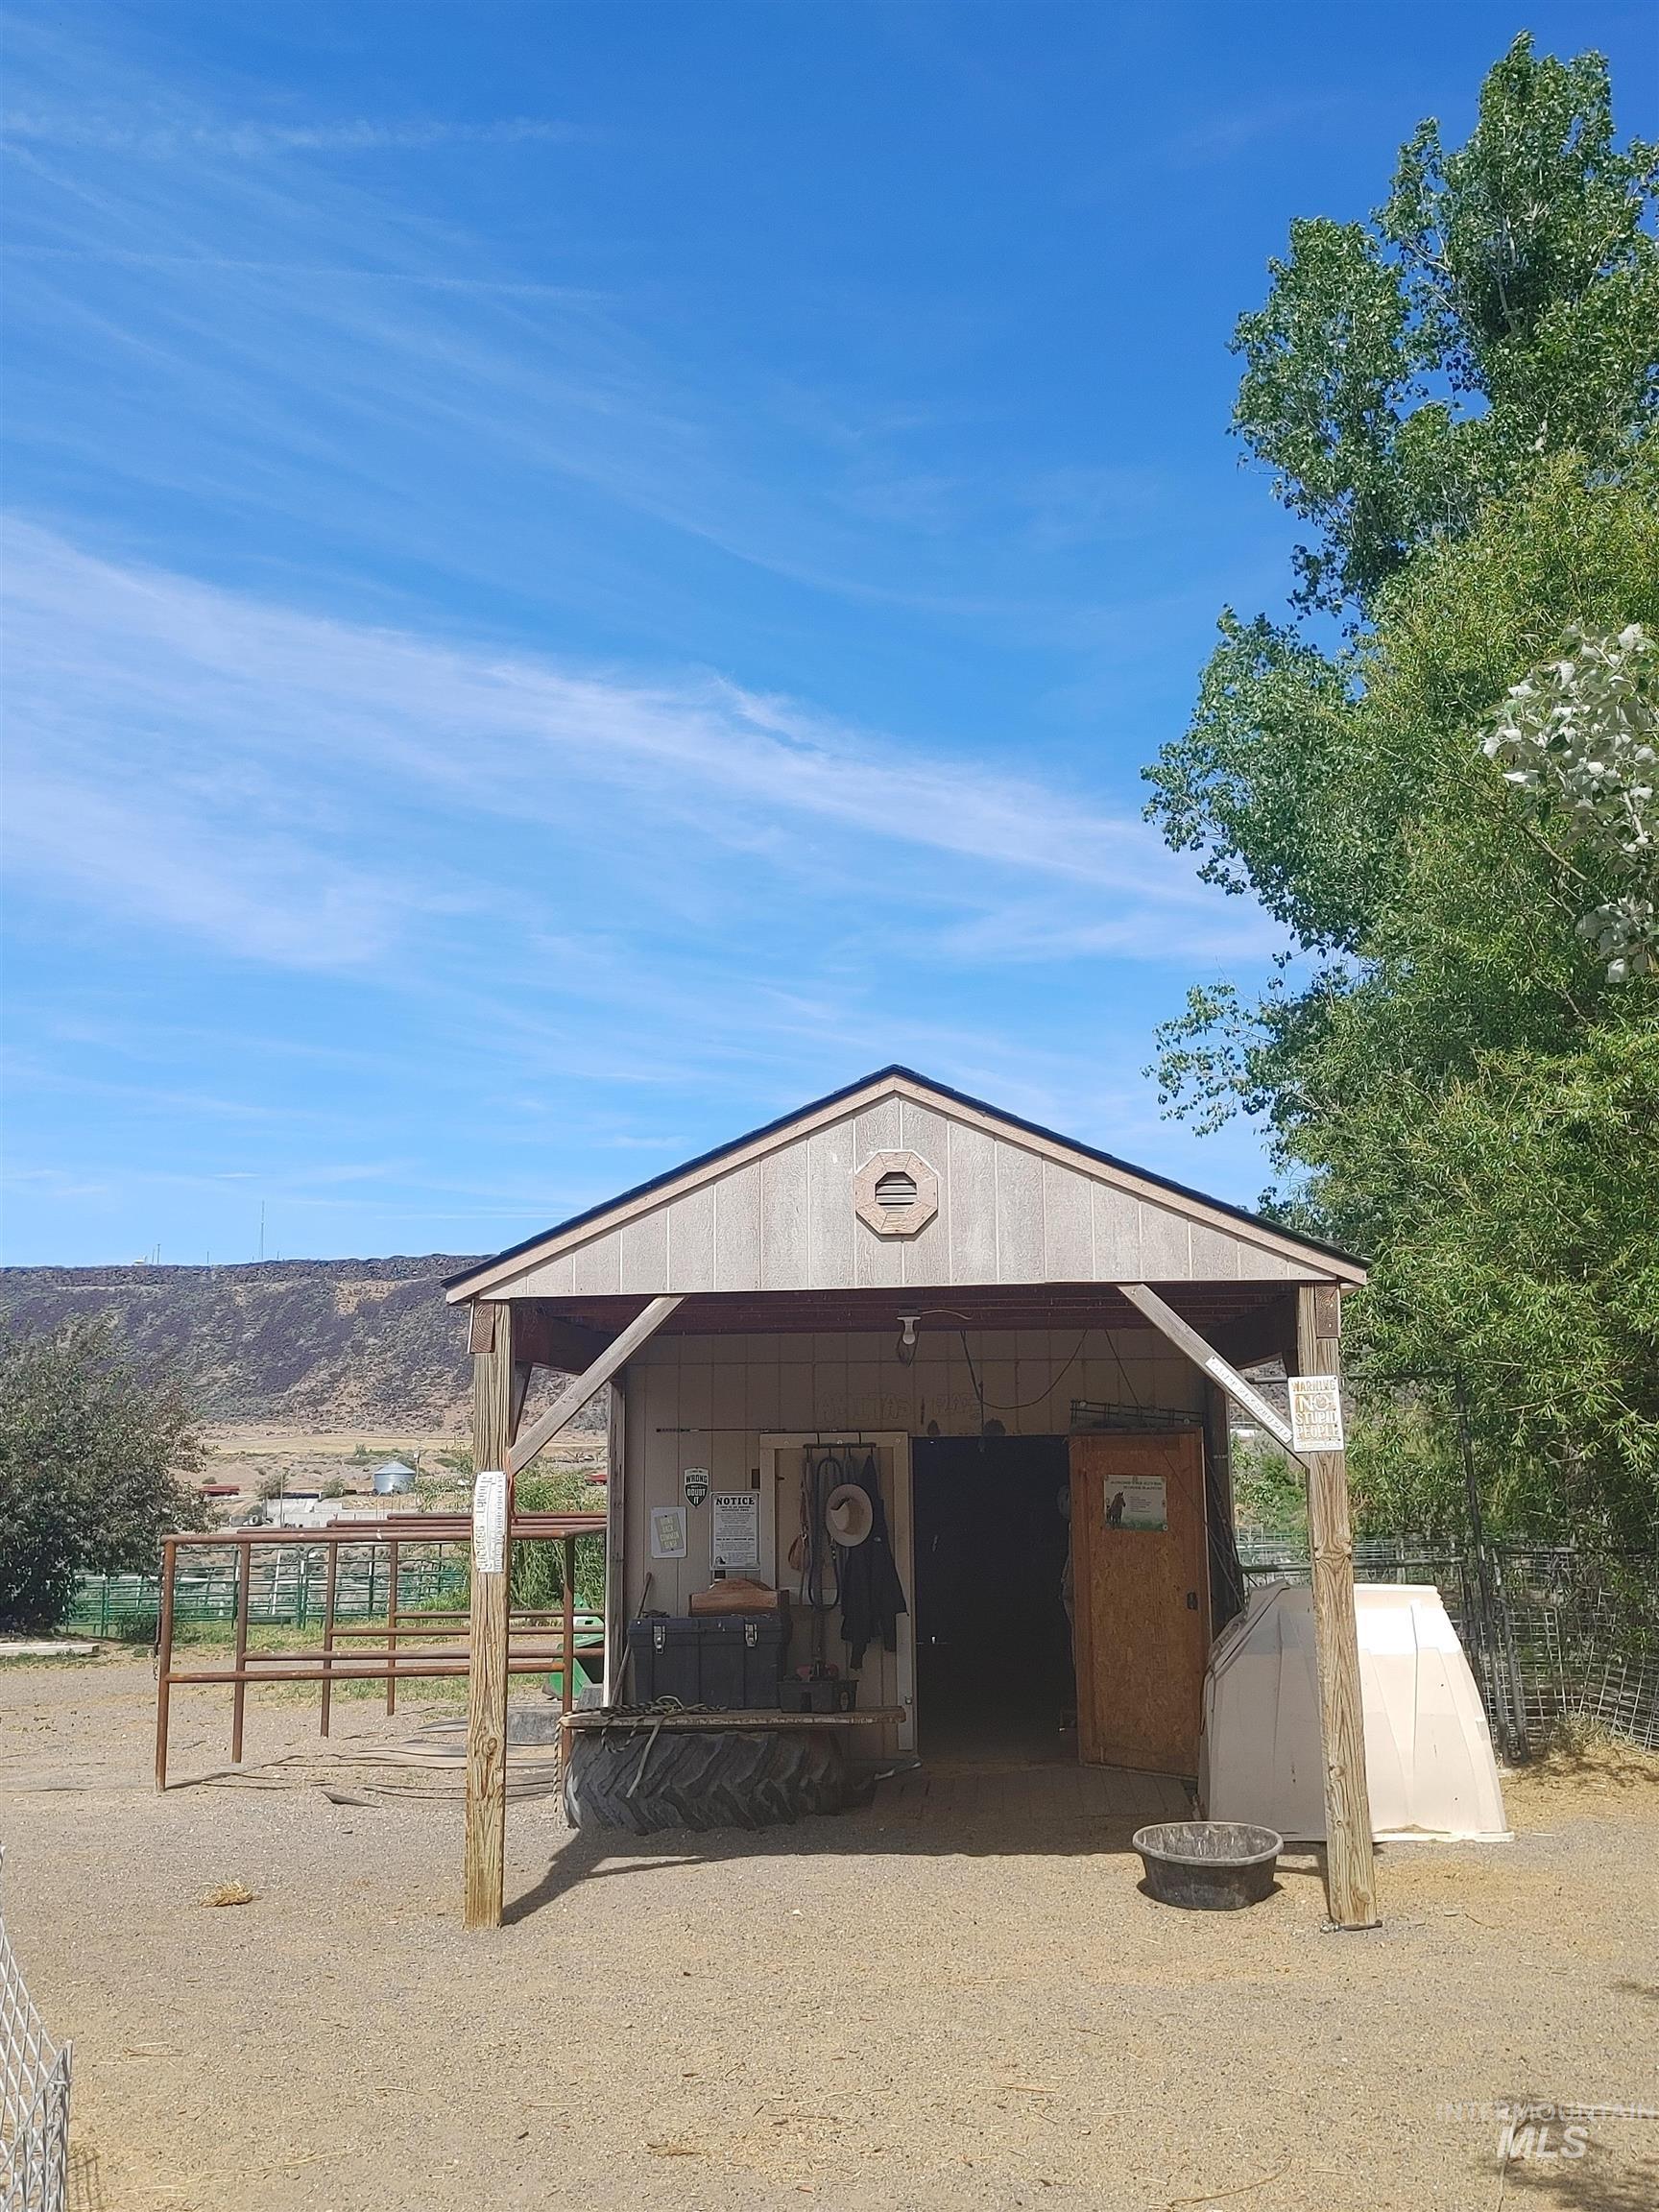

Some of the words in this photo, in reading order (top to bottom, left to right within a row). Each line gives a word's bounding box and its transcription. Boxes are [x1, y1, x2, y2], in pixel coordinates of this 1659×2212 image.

[1293, 1379, 1335, 1391] WARNING
[1296, 1393, 1330, 1412] NO
[1296, 1411, 1336, 1426] STUPID
[1297, 1424, 1339, 1439] PEOPLE
[686, 1474, 708, 1483] WRONG
[687, 1488, 706, 1497] DOUBT
[693, 1496, 699, 1504] IT
[715, 1497, 755, 1505] NOTICE
